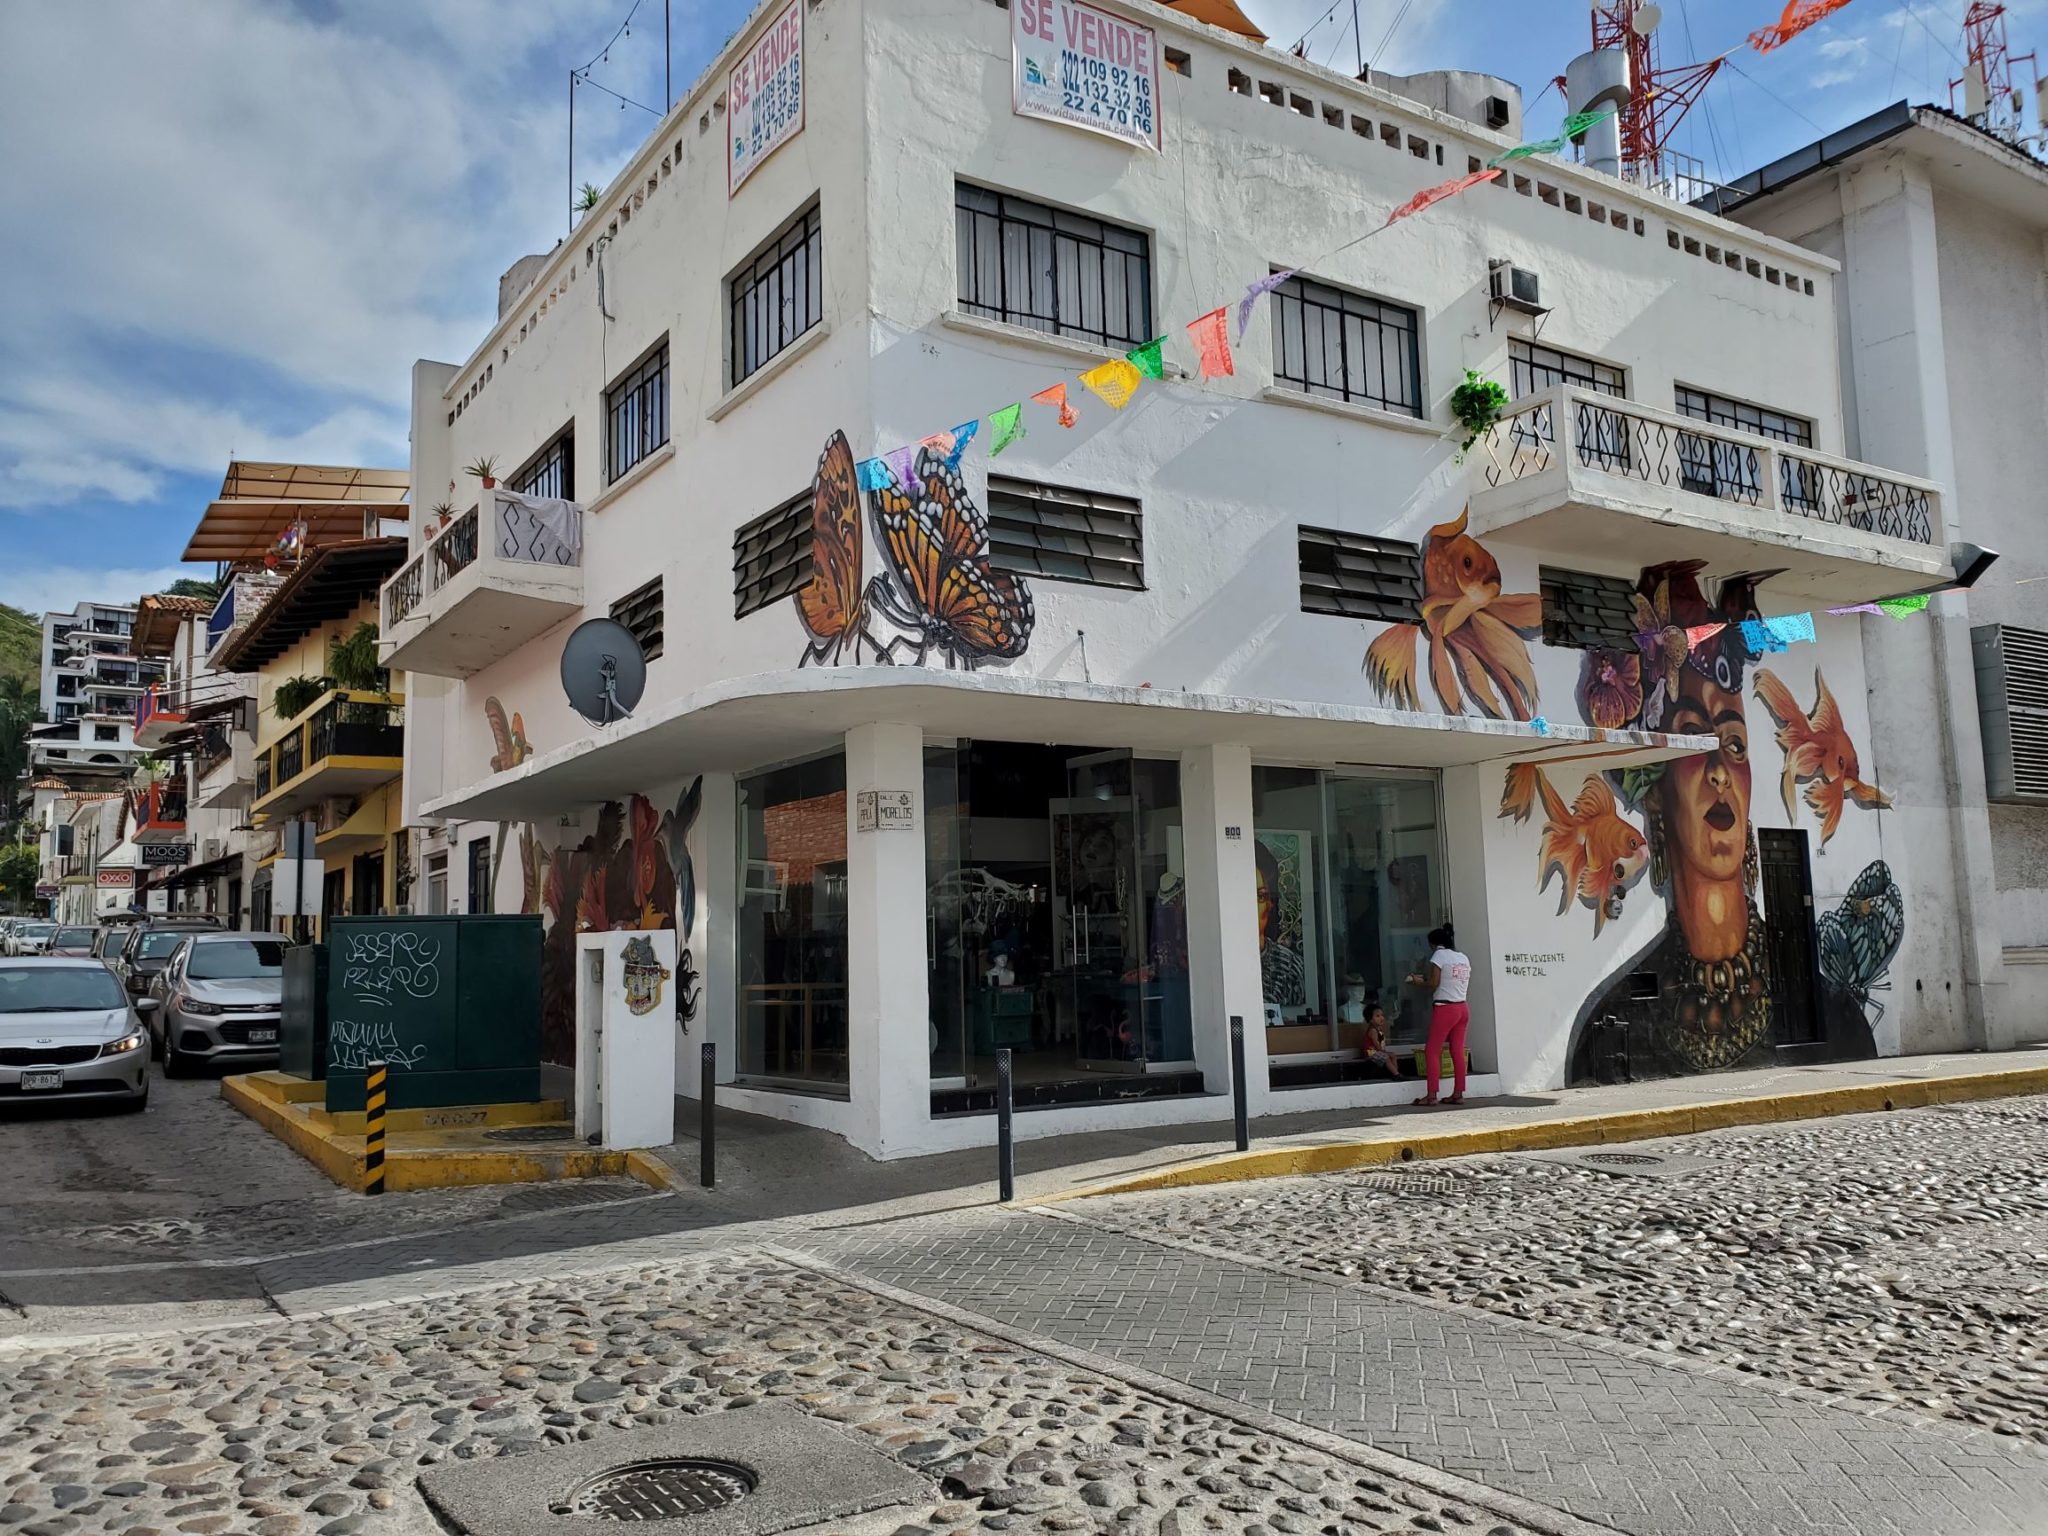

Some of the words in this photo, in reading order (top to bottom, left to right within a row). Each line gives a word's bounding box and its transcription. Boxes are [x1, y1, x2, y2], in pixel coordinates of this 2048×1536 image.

[1020, 0, 1054, 42] SE
[1061, 5, 1148, 75] VENDE
[733, 63, 750, 114] SE
[752, 7, 799, 93] VENDE
[761, 79, 775, 105] 109
[777, 65, 787, 89] 92
[789, 53, 799, 80] 16
[1081, 56, 1107, 81] 109
[1112, 67, 1128, 89] 92
[1134, 75, 1150, 96] 16
[761, 101, 776, 129] 132
[777, 89, 787, 115] 32
[789, 75, 800, 100] 36
[1064, 92, 1085, 112] 22
[1090, 102, 1101, 117] 4
[1107, 106, 1127, 125] 70
[1083, 79, 1109, 104] 132
[1114, 89, 1131, 110] 32
[1136, 99, 1152, 119] 36
[752, 137, 763, 157] 22
[765, 127, 771, 141] 4
[773, 112, 785, 135] 70
[787, 97, 799, 120] 86
[880, 806, 912, 820] MORELOS
[145, 846, 186, 857] MOOS
[99, 872, 131, 884] OXXO
